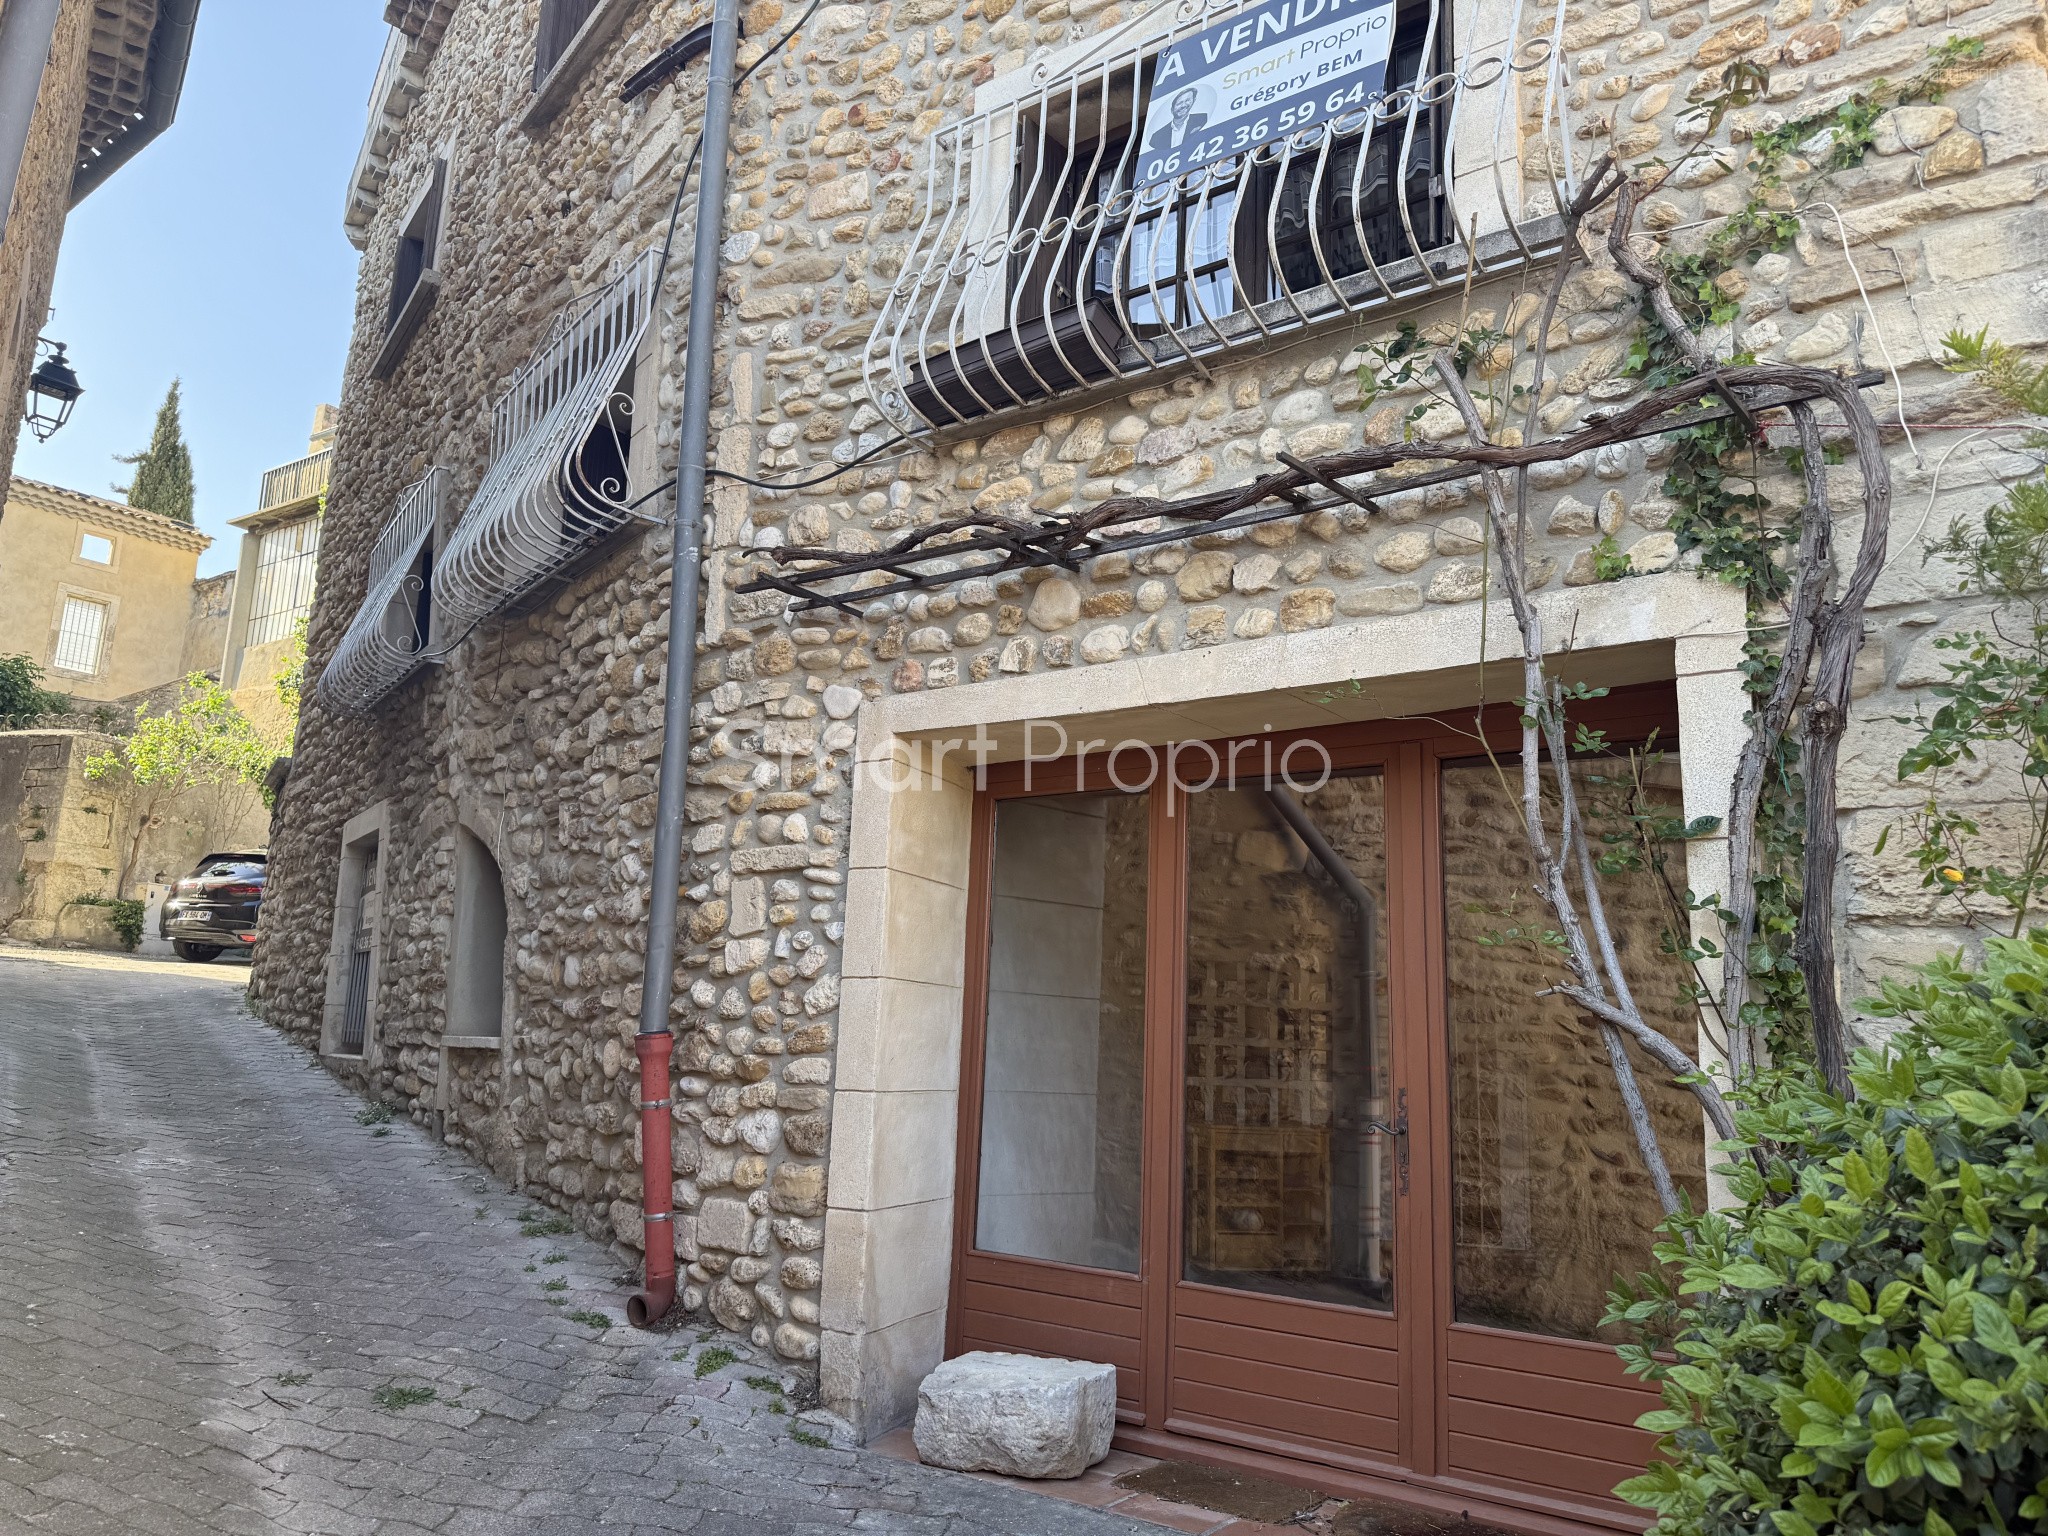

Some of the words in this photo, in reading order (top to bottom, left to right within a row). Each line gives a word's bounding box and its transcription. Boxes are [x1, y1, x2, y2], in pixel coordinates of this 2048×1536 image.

[1155, 51, 1185, 87] A
[1222, 49, 1295, 90] Smart
[1300, 16, 1387, 59] Proprio
[1230, 71, 1311, 110] Grégory
[1316, 49, 1363, 78] BEM
[1147, 151, 1181, 181] 06
[1188, 135, 1224, 162] 42
[1231, 117, 1268, 149] 36
[1278, 100, 1316, 132] 59
[1325, 81, 1365, 113] 64
